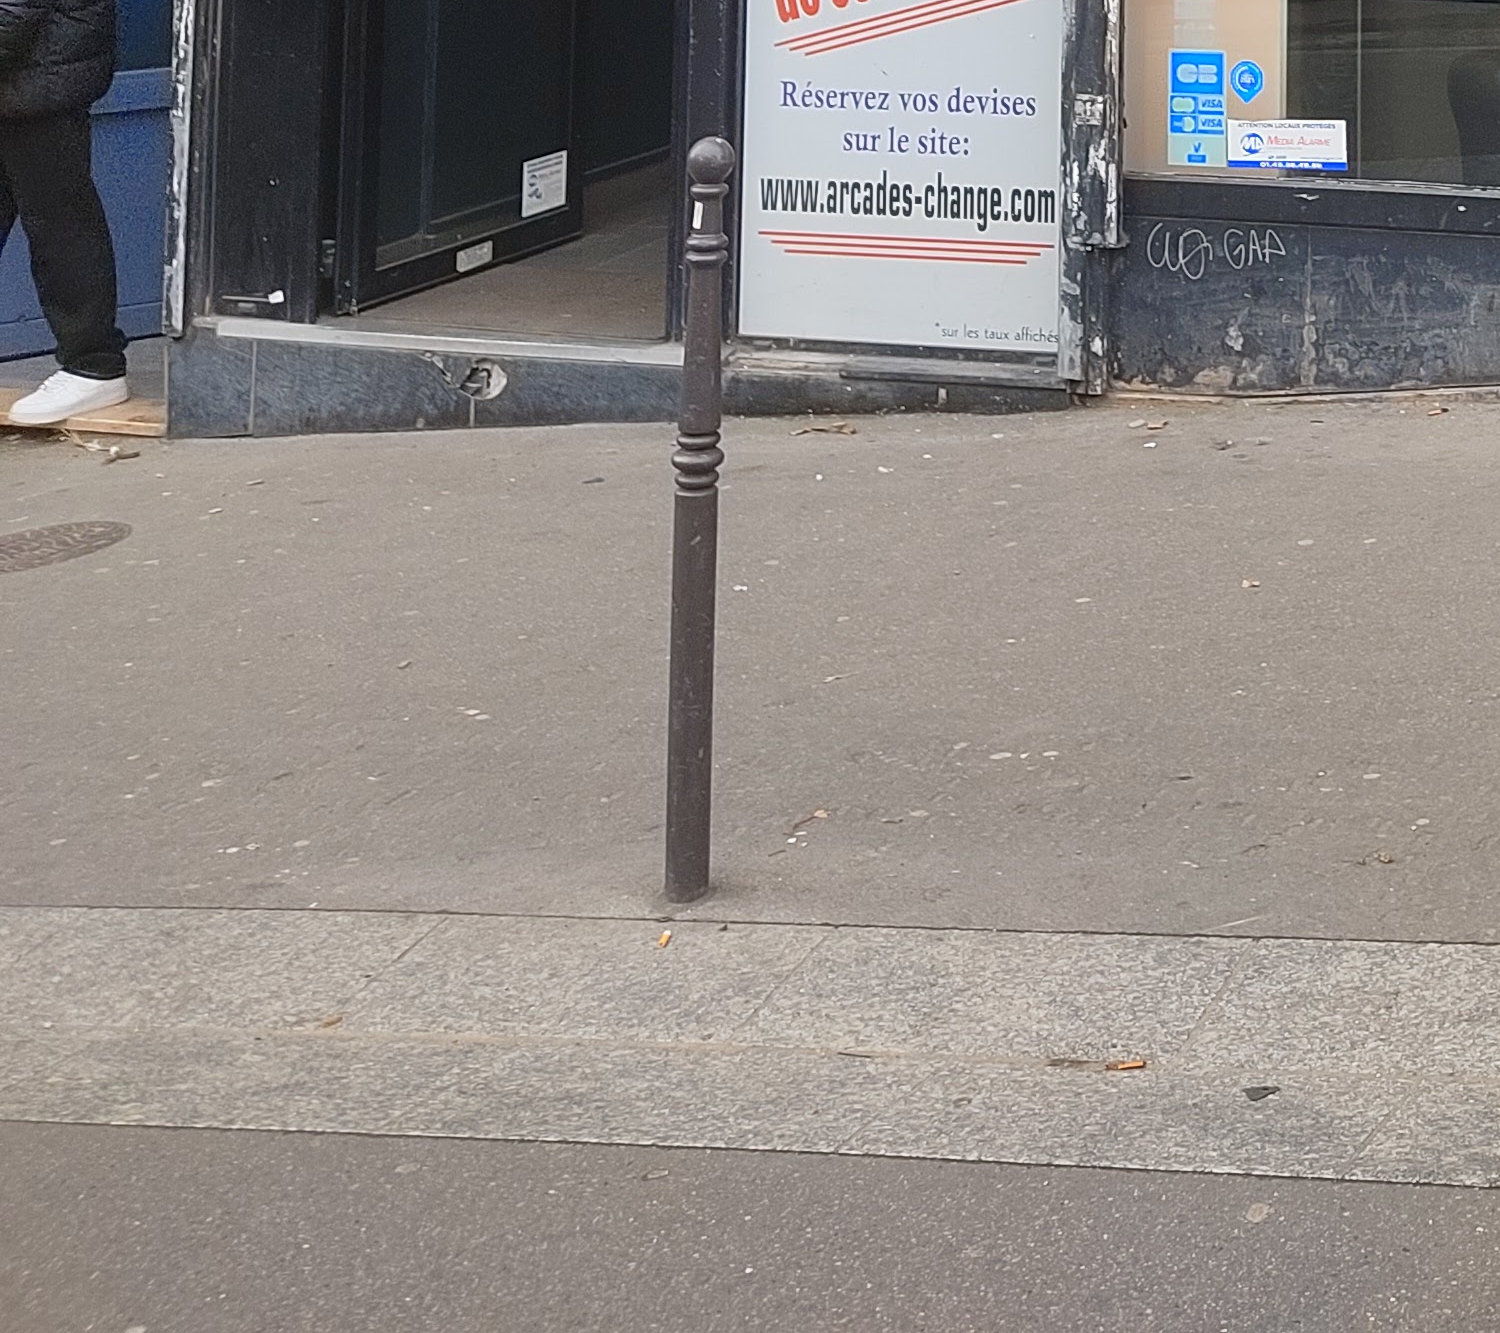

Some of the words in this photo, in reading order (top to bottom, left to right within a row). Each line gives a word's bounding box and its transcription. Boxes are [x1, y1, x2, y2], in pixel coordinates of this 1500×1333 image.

[780, 81, 889, 111] Réservez
[899, 93, 938, 113] vos
[947, 87, 1036, 116] devises
[1201, 99, 1223, 109] VISA
[1201, 119, 1223, 128] VISA
[843, 131, 880, 153] sur
[889, 126, 909, 153] le
[917, 129, 969, 156] site:
[760, 170, 1056, 232] www.arcades-change.com
[964, 323, 979, 338] les
[985, 329, 1009, 340] taux
[1015, 327, 1058, 343] affichés
